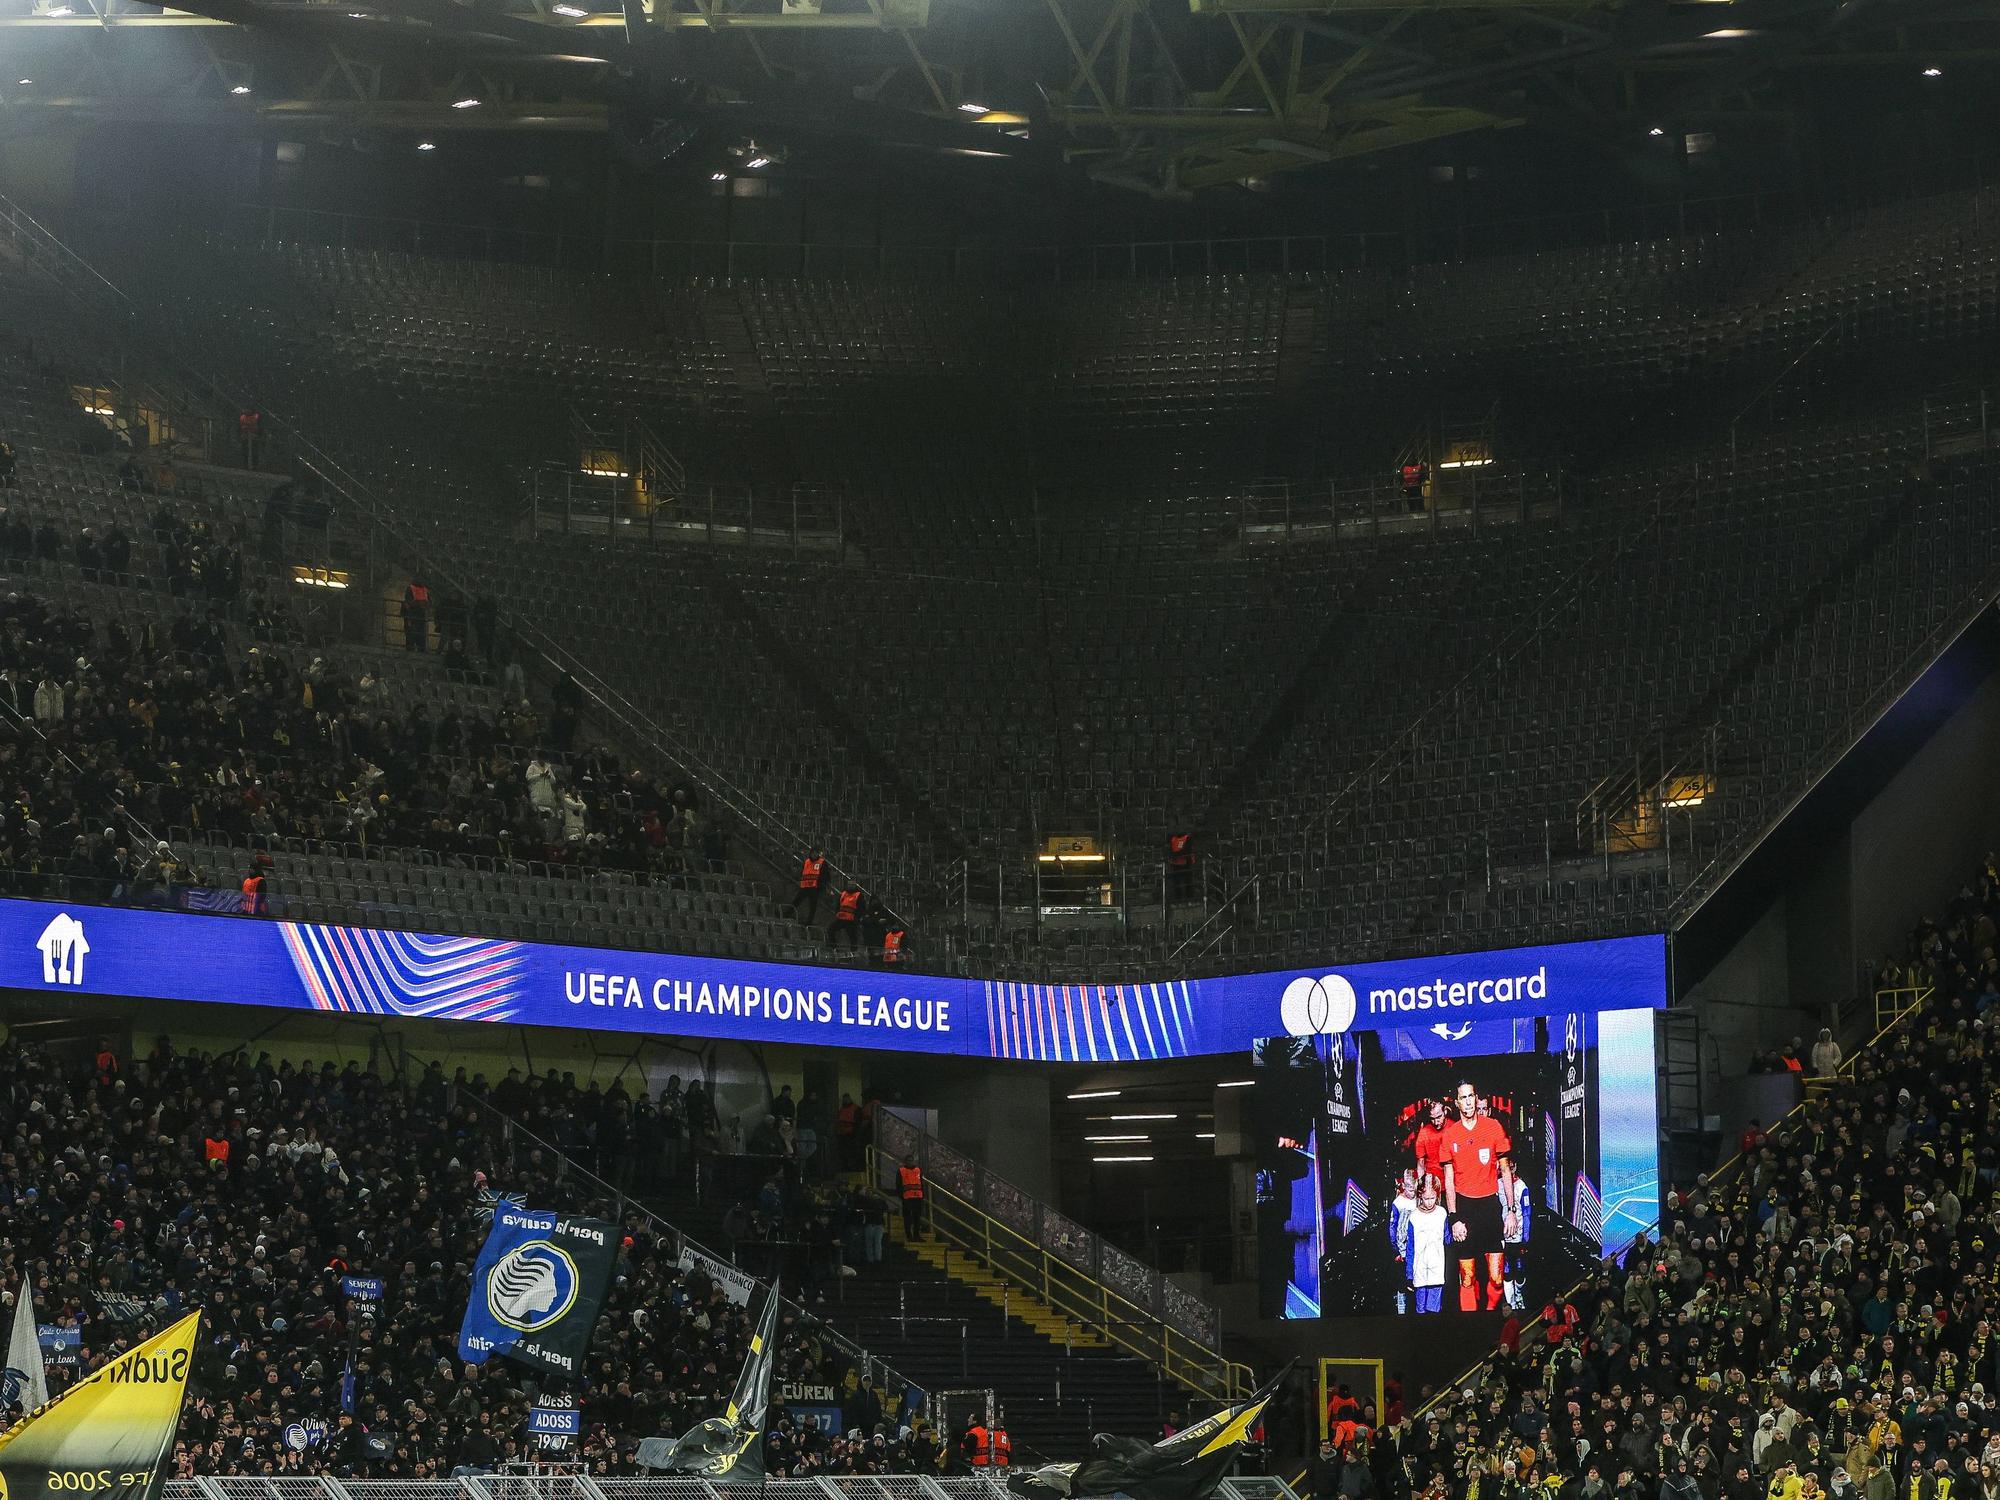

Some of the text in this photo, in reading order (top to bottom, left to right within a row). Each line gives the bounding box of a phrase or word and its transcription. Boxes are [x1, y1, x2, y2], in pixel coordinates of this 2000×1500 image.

[1369, 966, 1547, 1014] mastercard
[565, 971, 951, 1032] UEFA CHAMPIONS LEAGUE
[1561, 1083, 1584, 1105] CHAMPIONS
[1327, 1100, 1351, 1119] CHAMPIONS
[1564, 1102, 1581, 1119] LEAGUE
[1331, 1118, 1349, 1134] LEAGUE
[728, 1272, 753, 1292] BIANCO
[44, 1354, 77, 1365] in tour
[538, 1393, 573, 1408] ADESS
[536, 1413, 572, 1429] ADOSS
